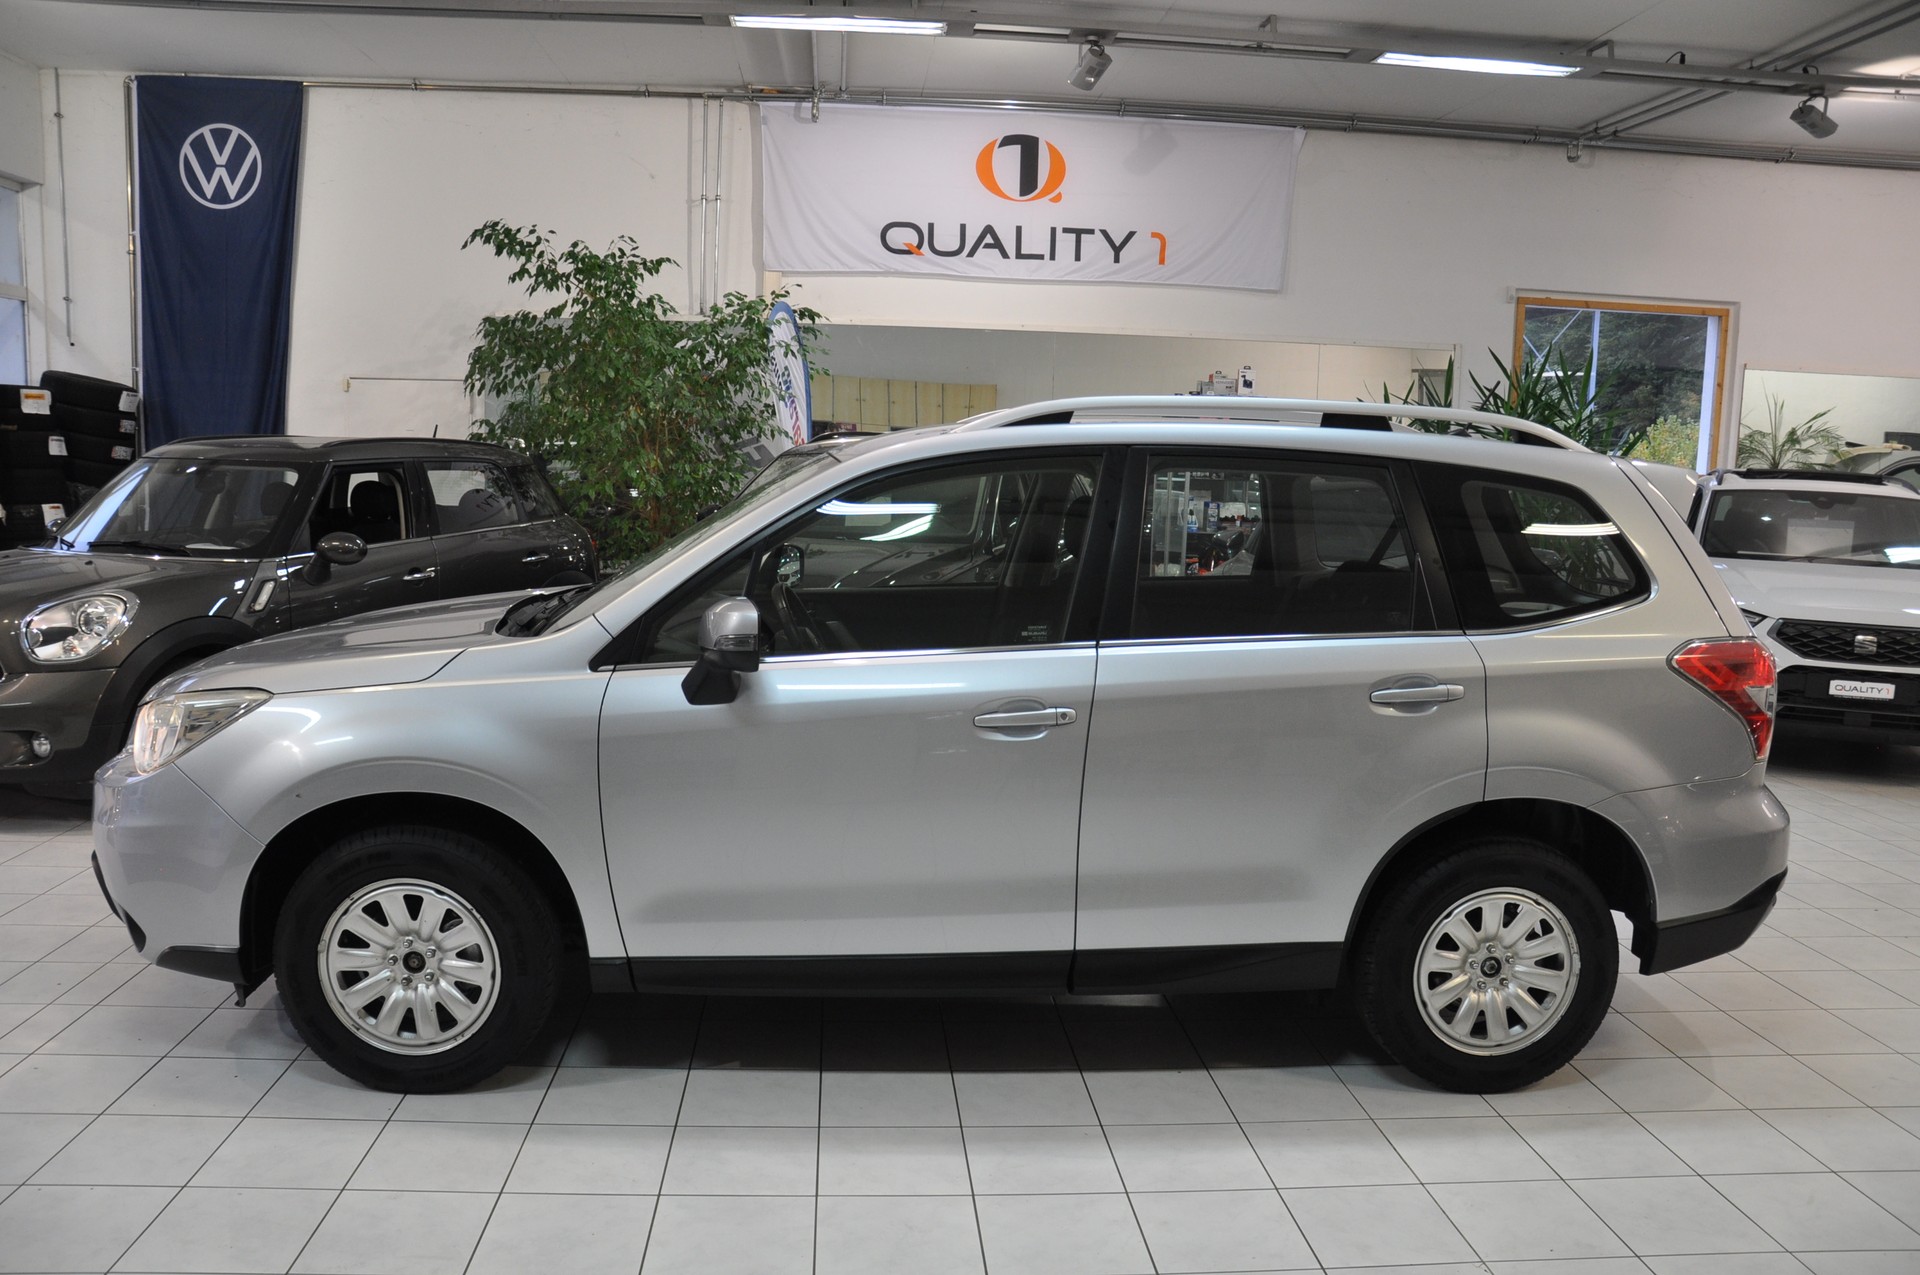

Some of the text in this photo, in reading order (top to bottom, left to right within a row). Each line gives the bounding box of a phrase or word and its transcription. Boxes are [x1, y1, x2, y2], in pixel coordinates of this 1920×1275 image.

[180, 124, 261, 208] VW
[880, 221, 1168, 266] QUALITY 1
[1835, 685, 1884, 694] QUALITY
